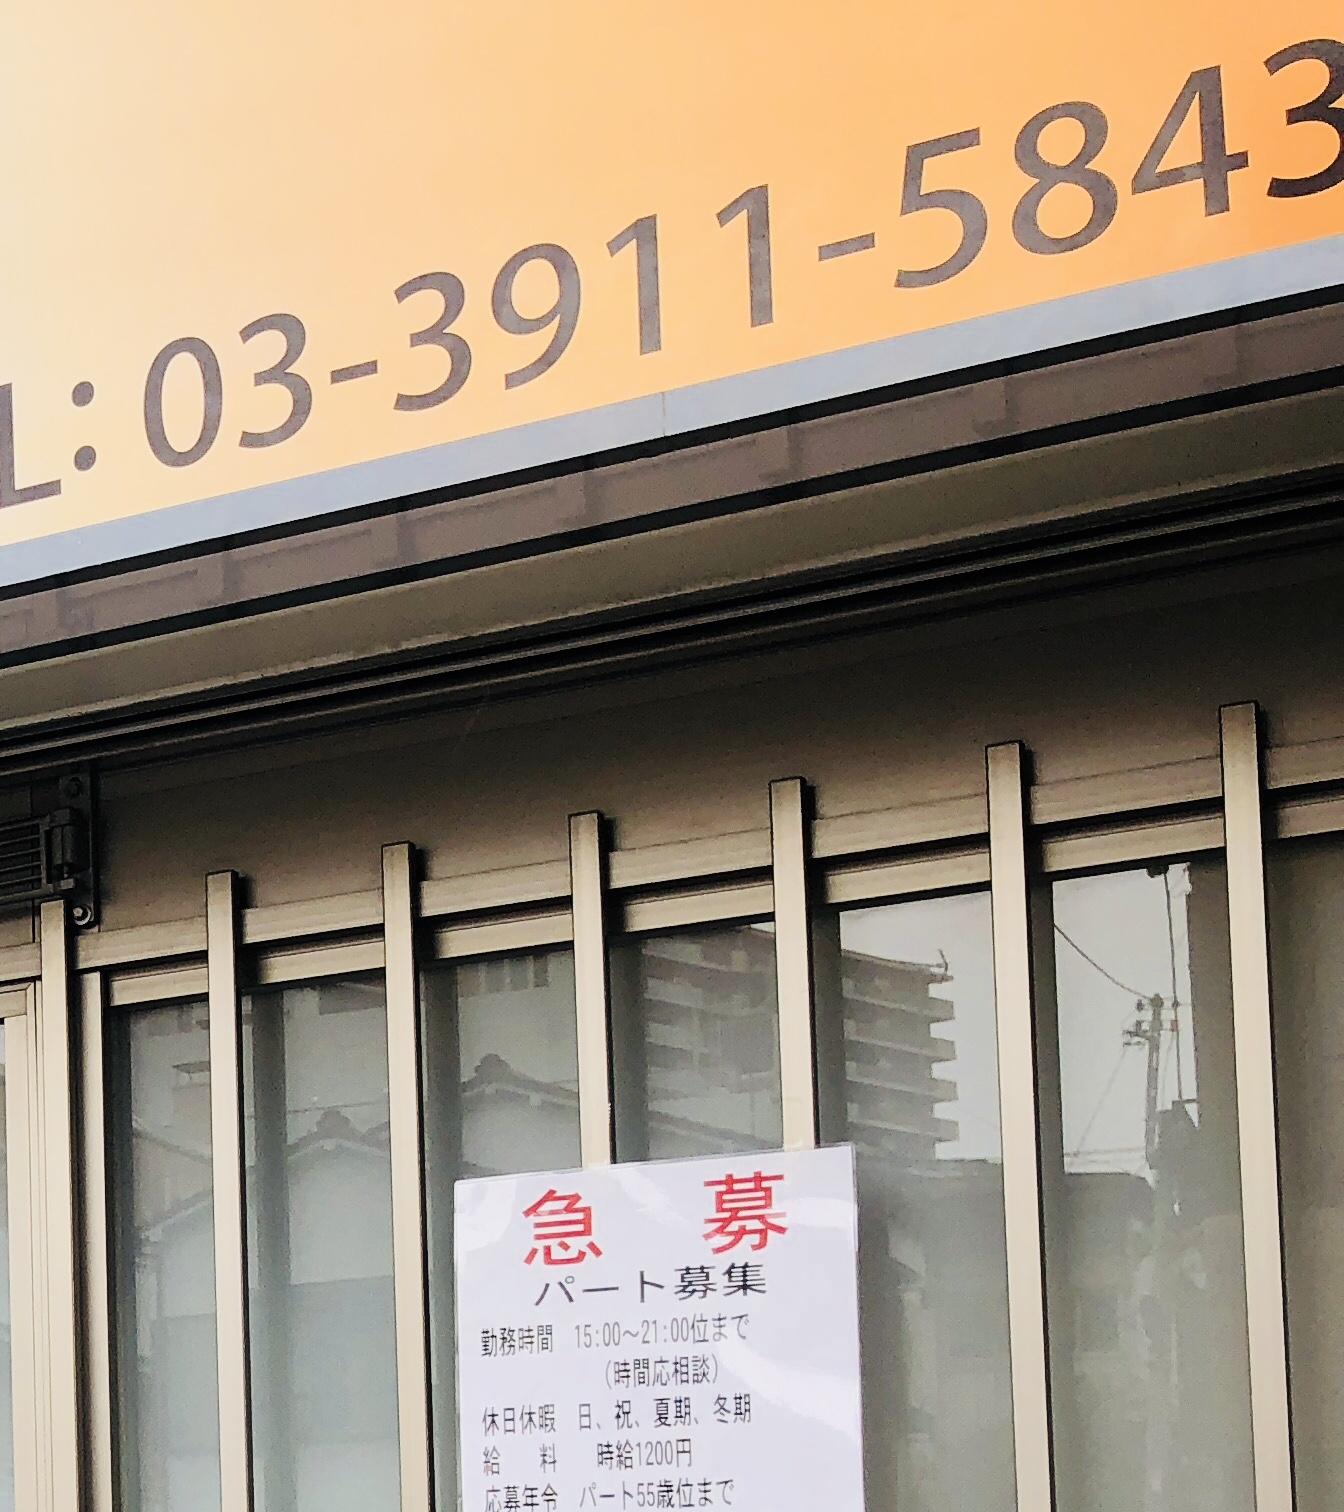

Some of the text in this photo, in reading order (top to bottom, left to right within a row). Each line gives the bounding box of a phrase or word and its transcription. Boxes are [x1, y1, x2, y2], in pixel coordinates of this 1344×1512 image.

[142, 36, 1344, 470] 03-3911-5843
[534, 1262, 767, 1306] パート募集
[480, 1324, 553, 1357] 勤務時間
[481, 1404, 557, 1436] 休日休暇
[596, 1438, 693, 1471] 時給1200円
[579, 1479, 735, 1511] パート55歳位まで
